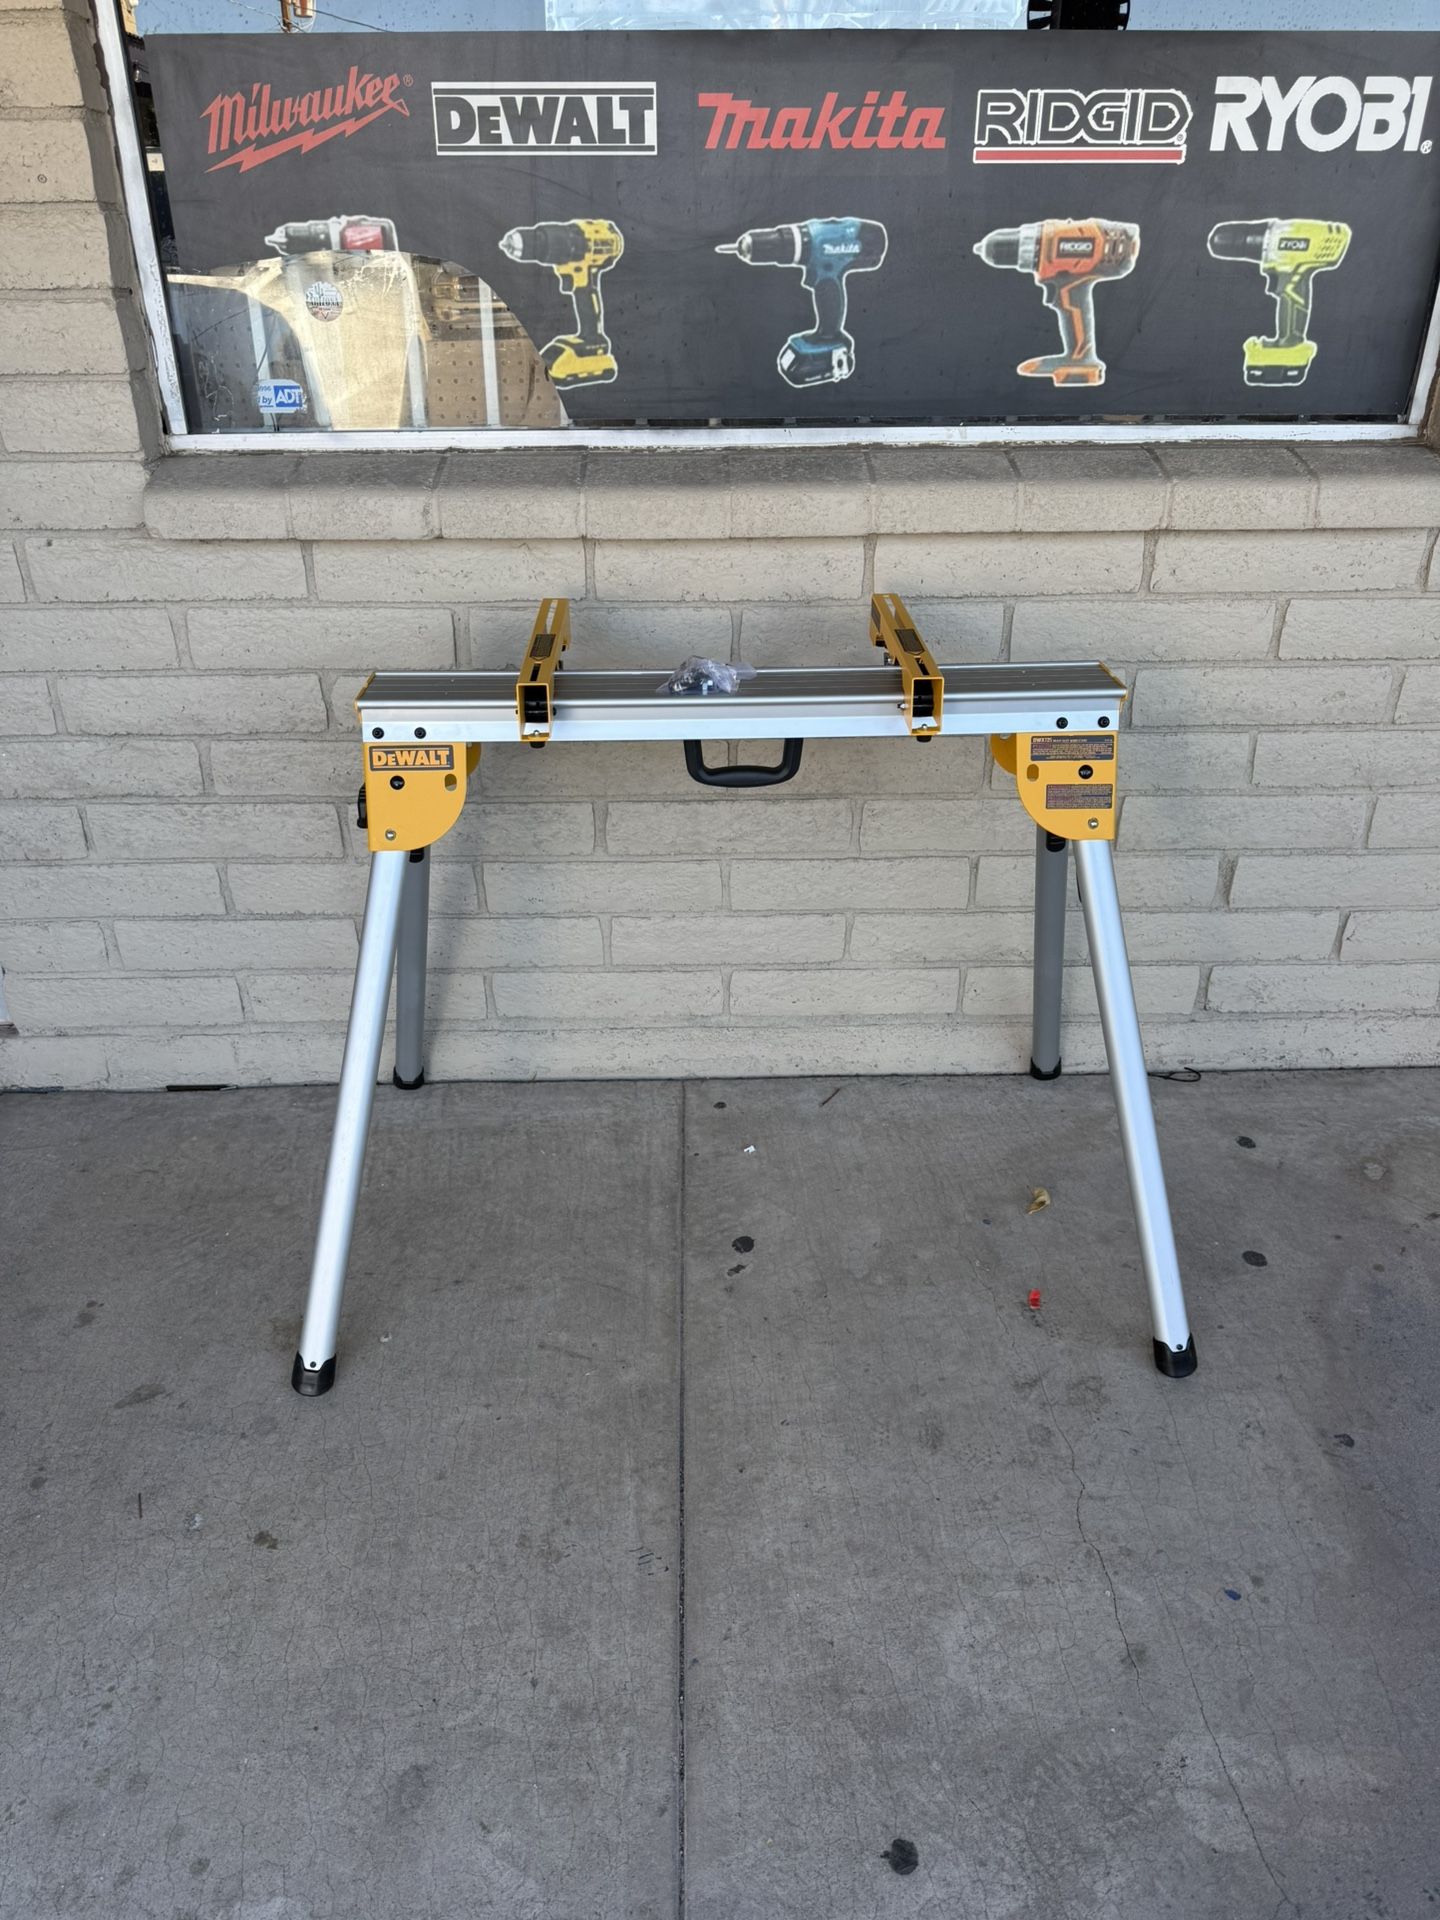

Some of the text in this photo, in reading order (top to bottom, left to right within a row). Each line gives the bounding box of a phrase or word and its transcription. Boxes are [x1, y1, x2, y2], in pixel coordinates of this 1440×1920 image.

[200, 65, 409, 154] Milwaukee
[698, 91, 946, 149] Makita
[974, 88, 1194, 145] RIDGID
[1210, 76, 1433, 152] RYOBI
[1059, 241, 1093, 252] RIDGID
[275, 389, 302, 404] ADT
[372, 750, 450, 766] DEWALT
